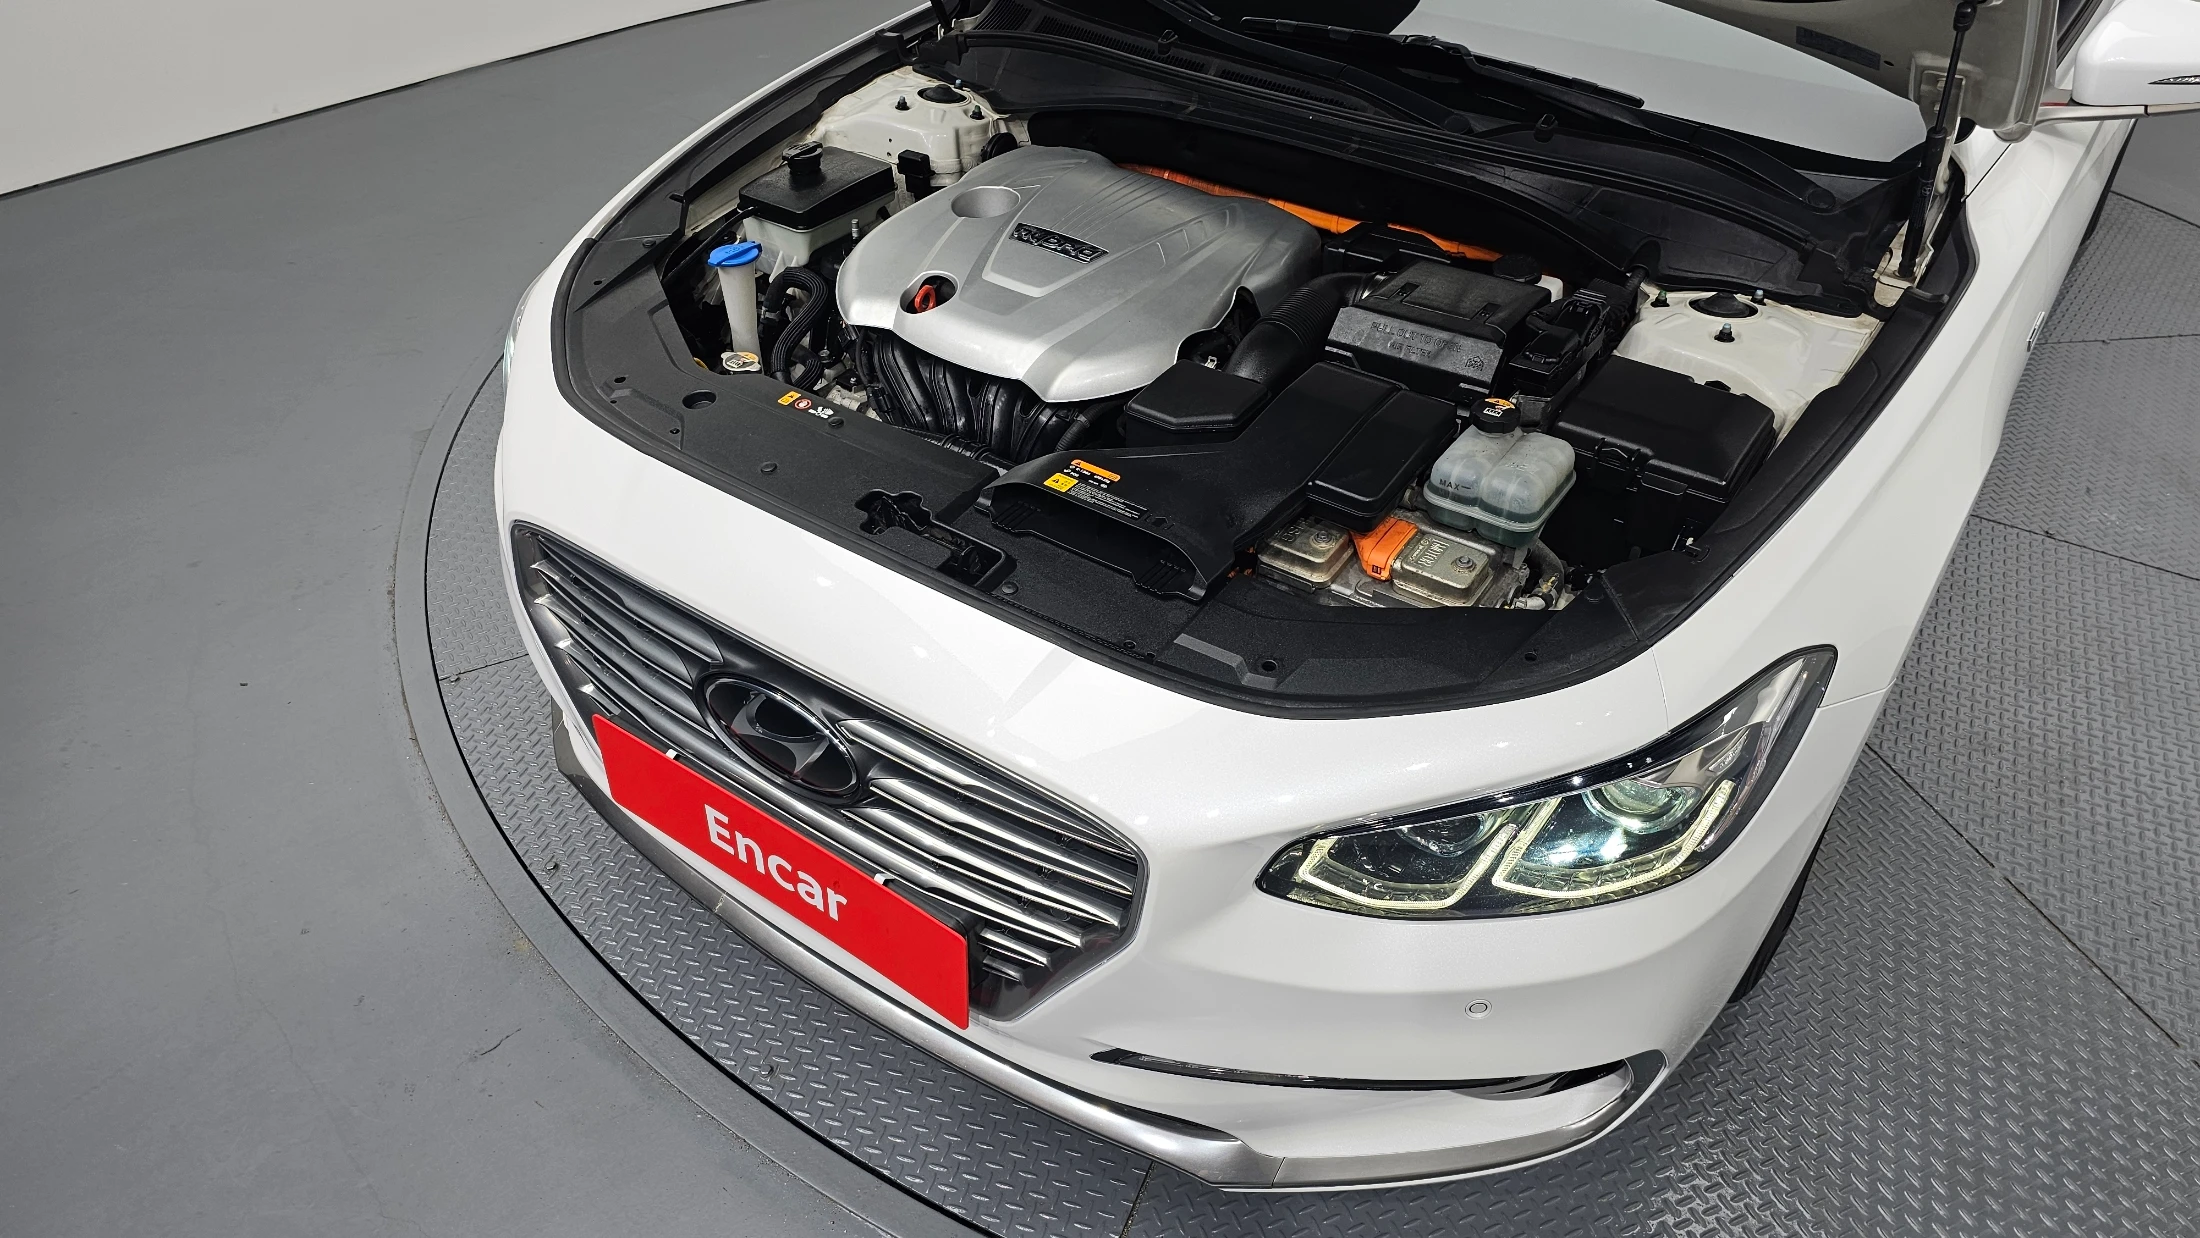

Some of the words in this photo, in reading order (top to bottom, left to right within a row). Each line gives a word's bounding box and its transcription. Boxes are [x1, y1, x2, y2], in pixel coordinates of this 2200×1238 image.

[1371, 321, 1395, 336] PULL
[1397, 328, 1419, 341] OUT
[1439, 478, 1459, 491] MAX
[704, 804, 848, 921] Encar
